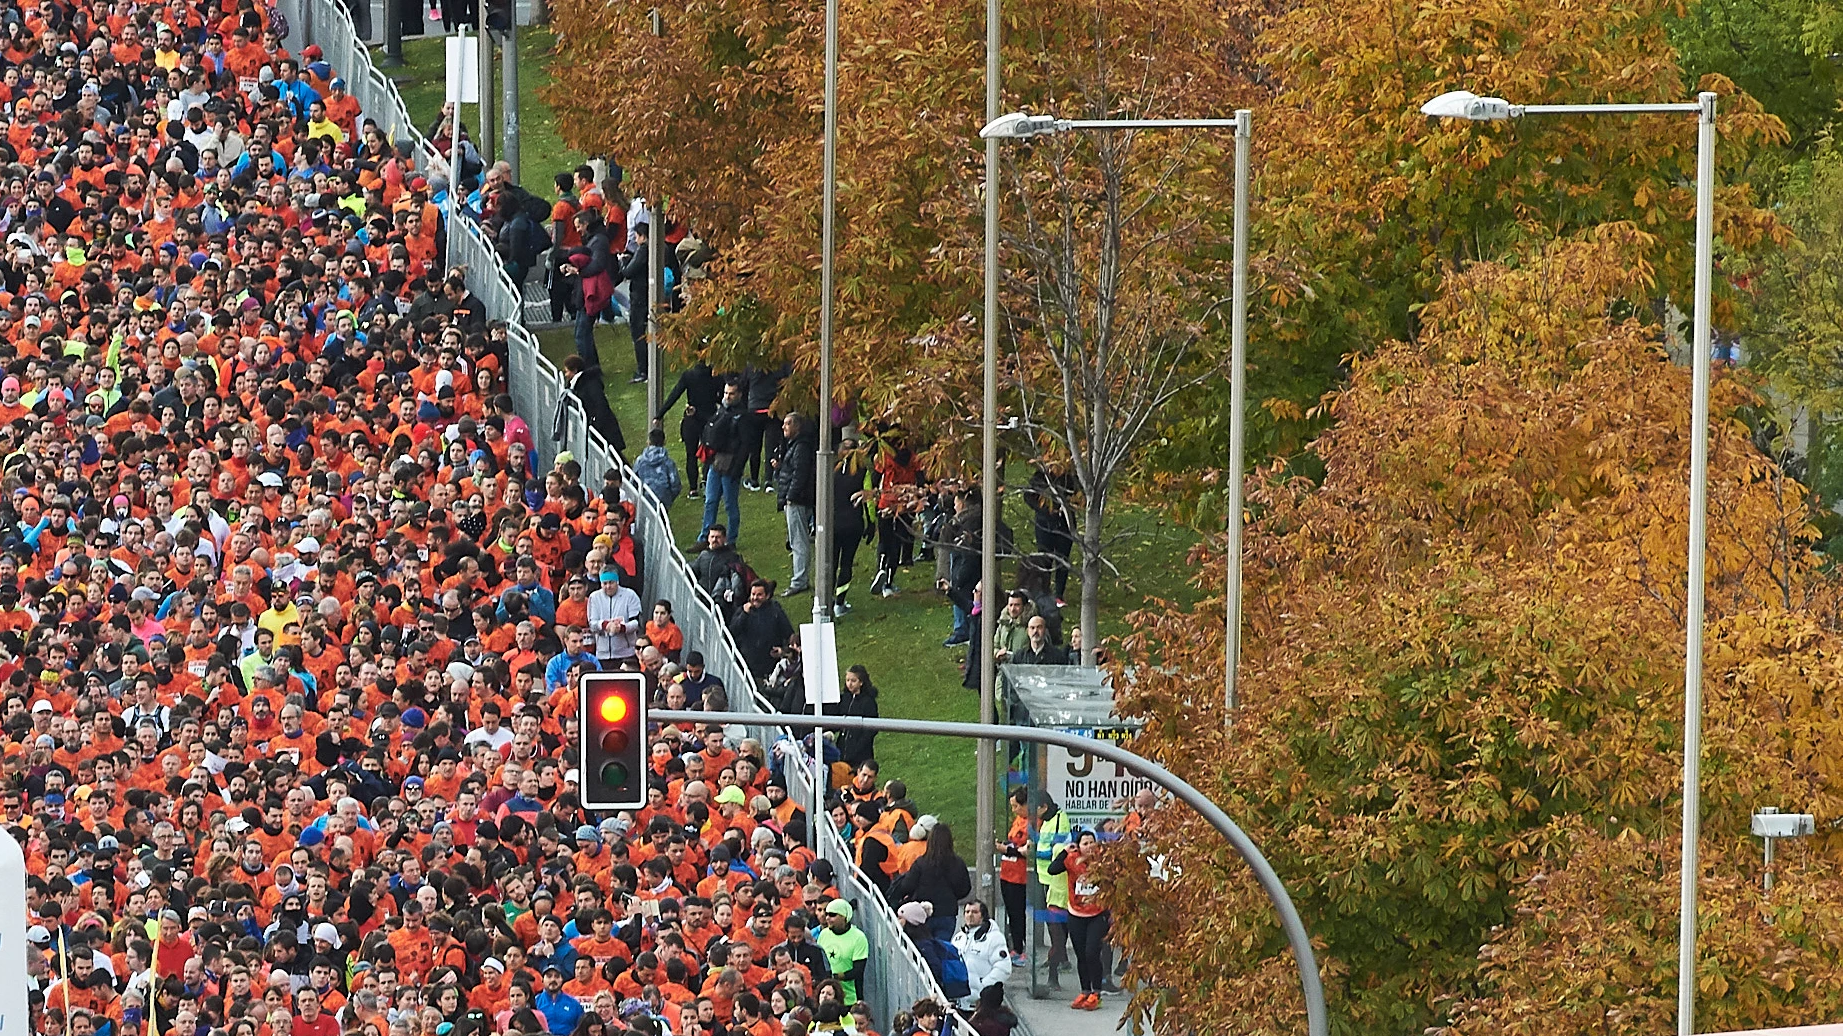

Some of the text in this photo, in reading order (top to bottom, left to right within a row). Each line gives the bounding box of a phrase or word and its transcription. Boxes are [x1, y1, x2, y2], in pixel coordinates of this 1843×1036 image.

[1065, 780, 1084, 798] NO
[1088, 780, 1117, 798] HAN
[1065, 799, 1109, 810] HABLAR DE
